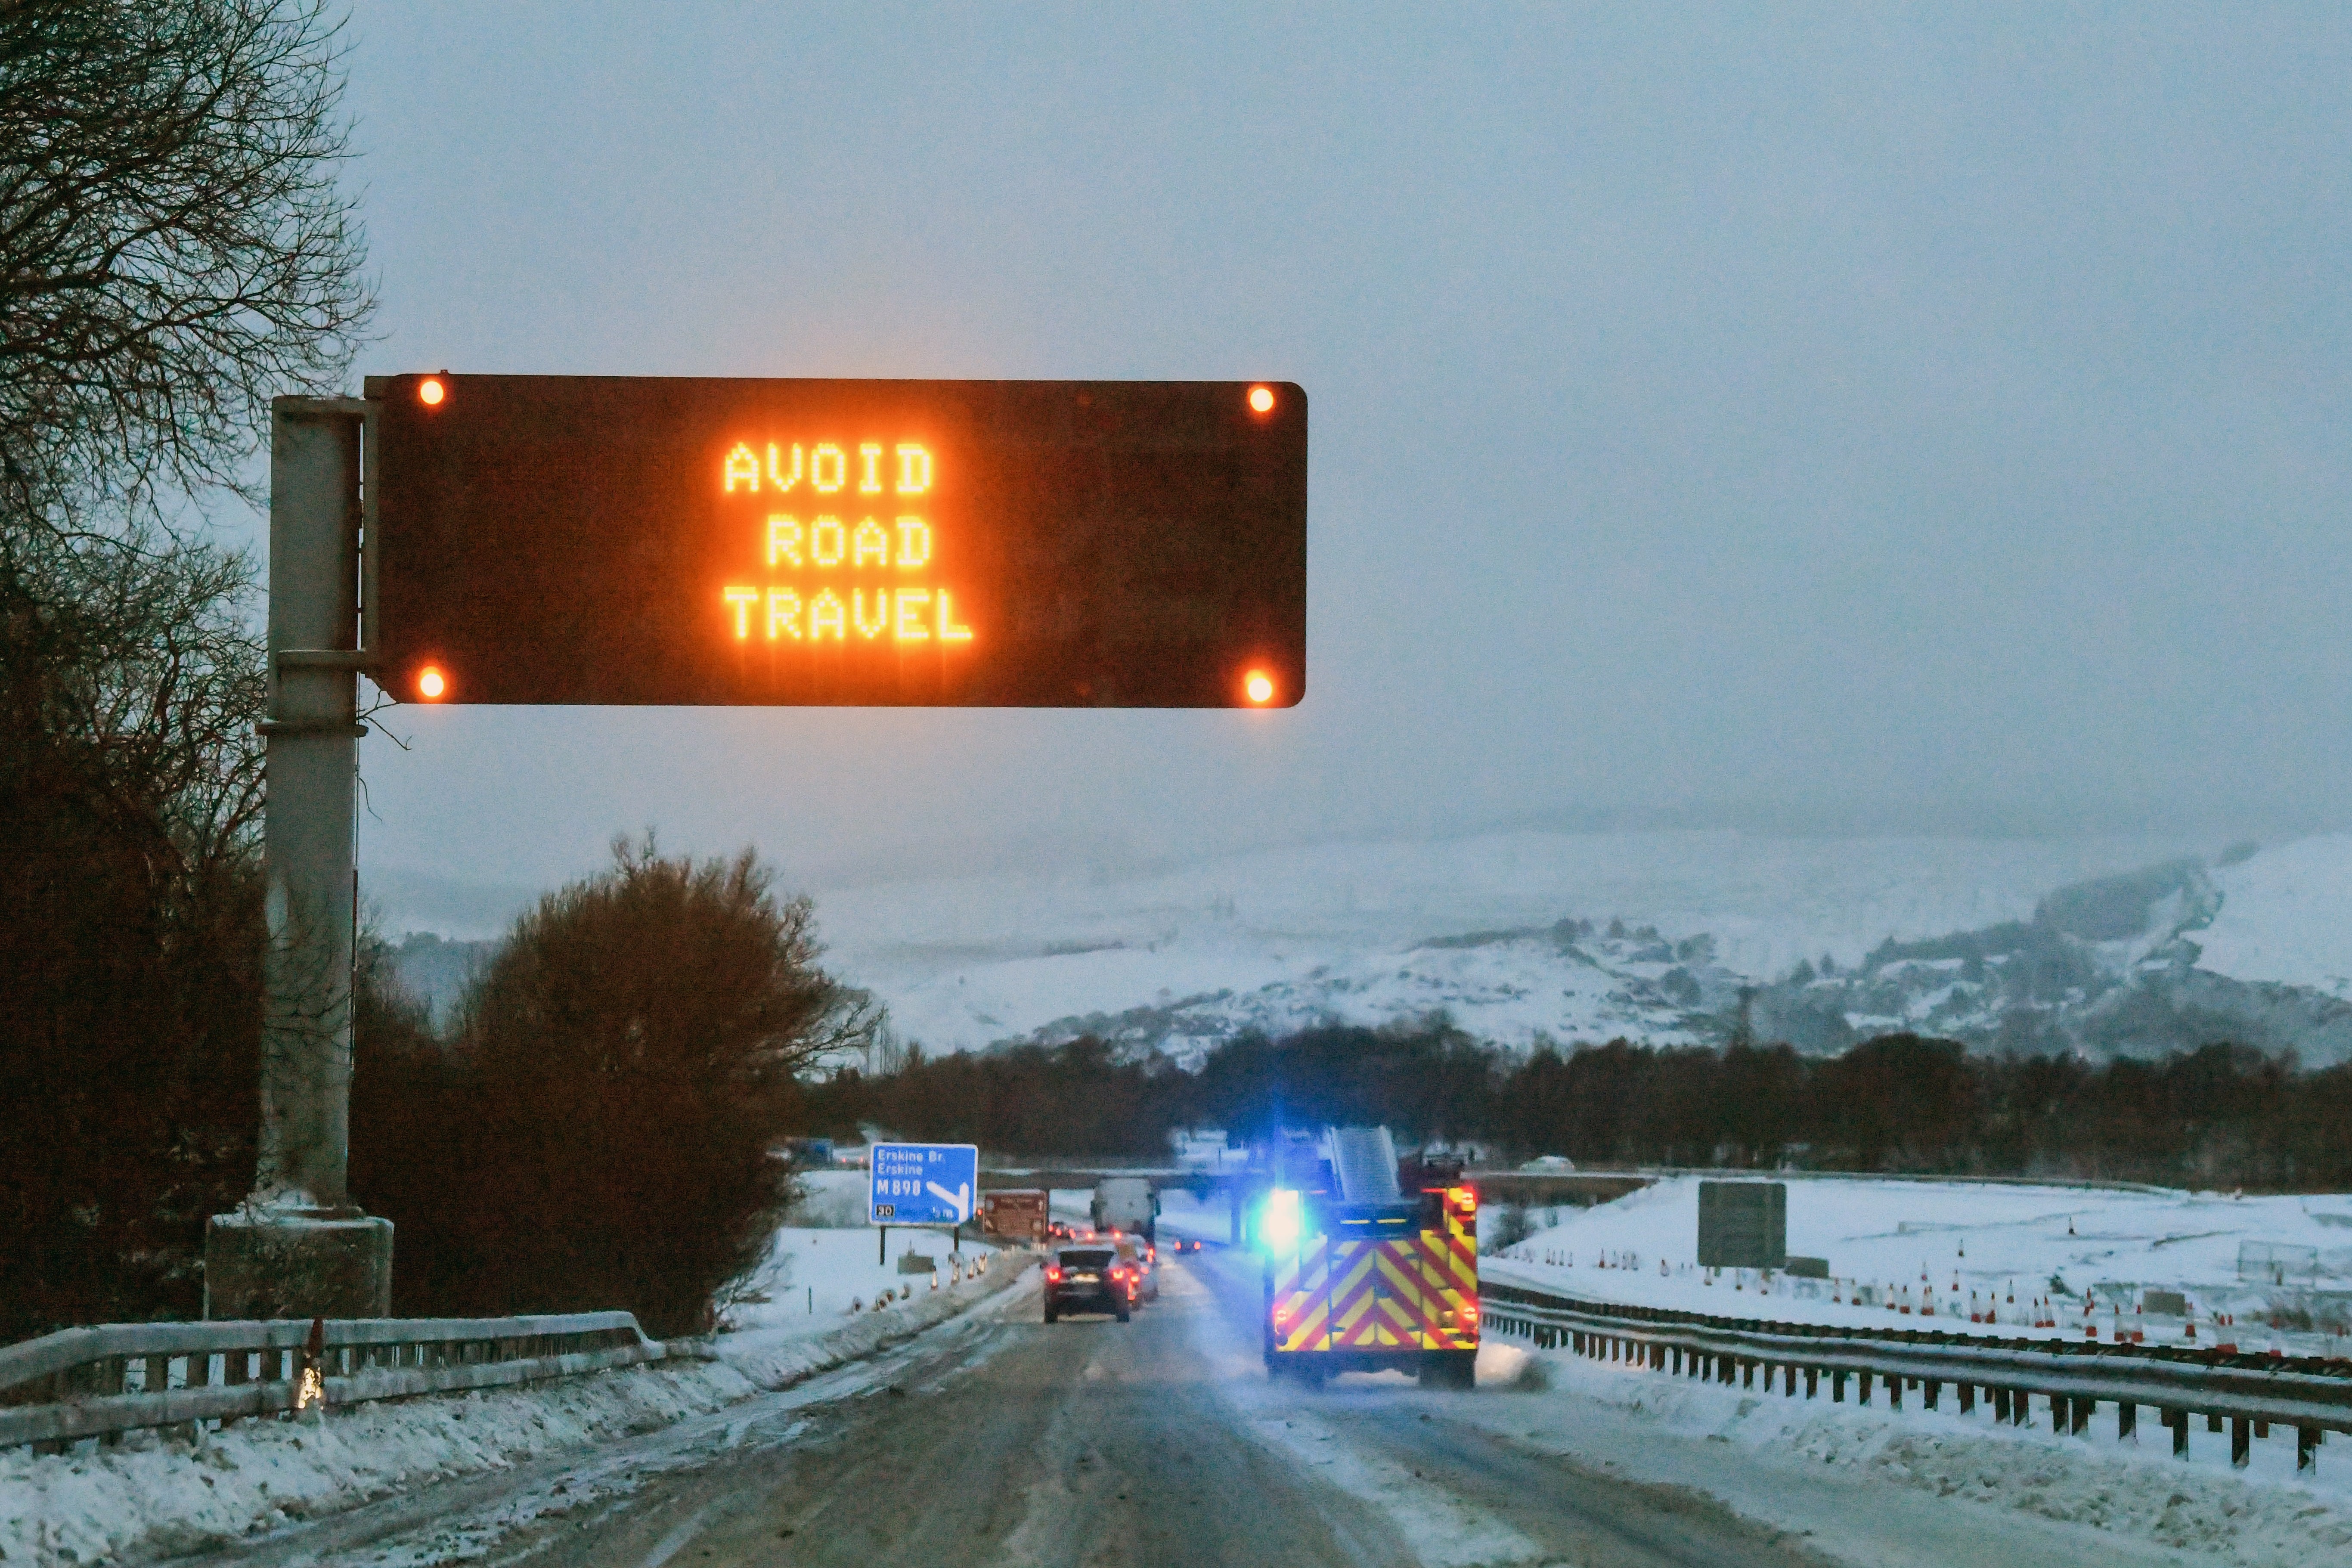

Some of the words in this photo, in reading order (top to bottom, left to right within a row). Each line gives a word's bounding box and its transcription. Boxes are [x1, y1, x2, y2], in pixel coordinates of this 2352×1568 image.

[725, 442, 934, 493] AVOID
[767, 514, 933, 567] ROAD
[724, 586, 973, 640] TRAVEL
[878, 1150, 923, 1162] Erskine
[878, 1163, 923, 1175] Erskine
